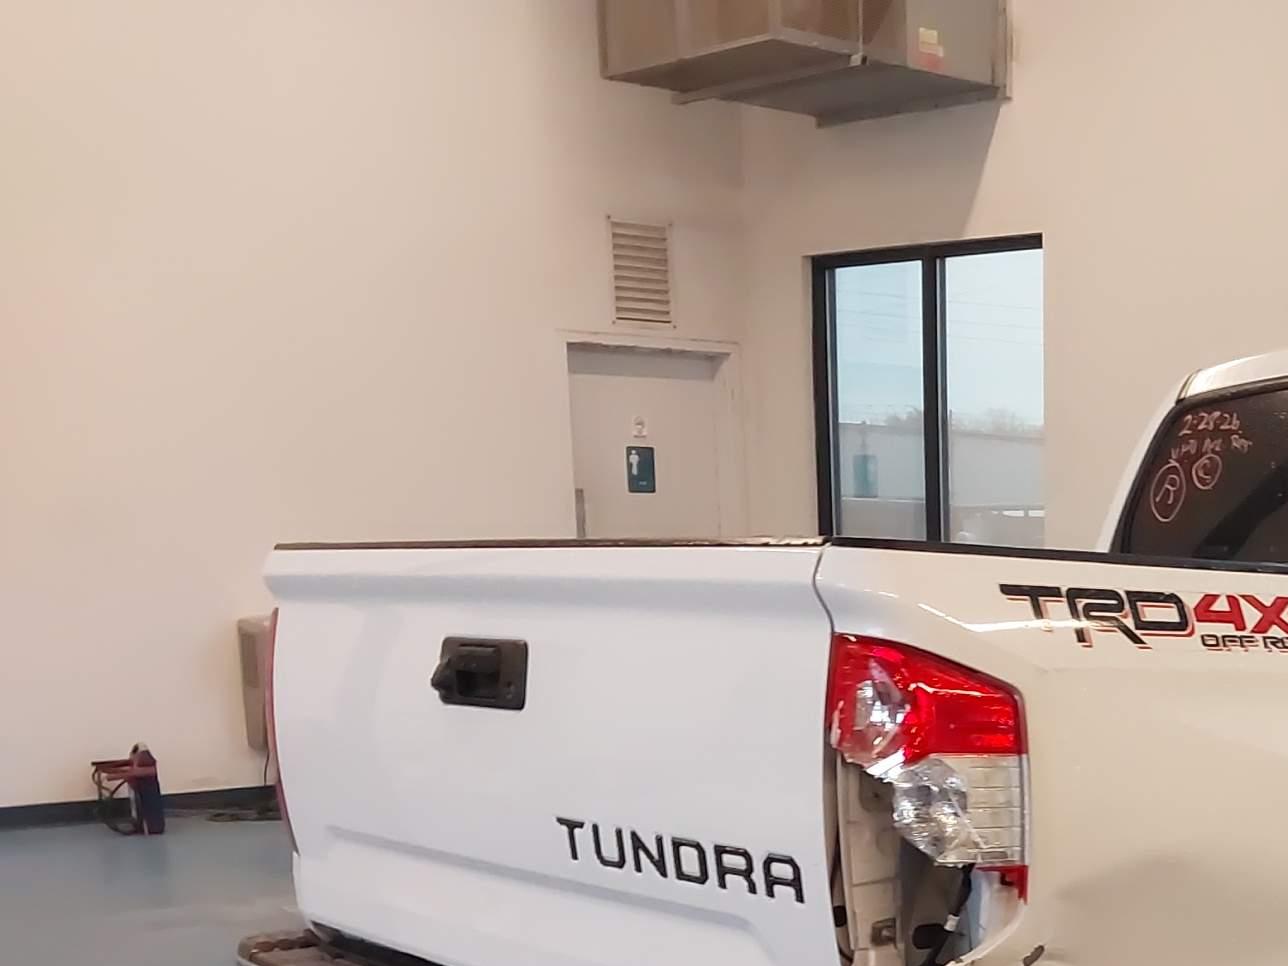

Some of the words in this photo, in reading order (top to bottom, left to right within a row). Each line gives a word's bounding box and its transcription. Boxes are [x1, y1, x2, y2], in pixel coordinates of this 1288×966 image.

[1000, 583, 1195, 649] TRD
[1201, 634, 1259, 652] OFF
[556, 816, 805, 904] TUNDRA
